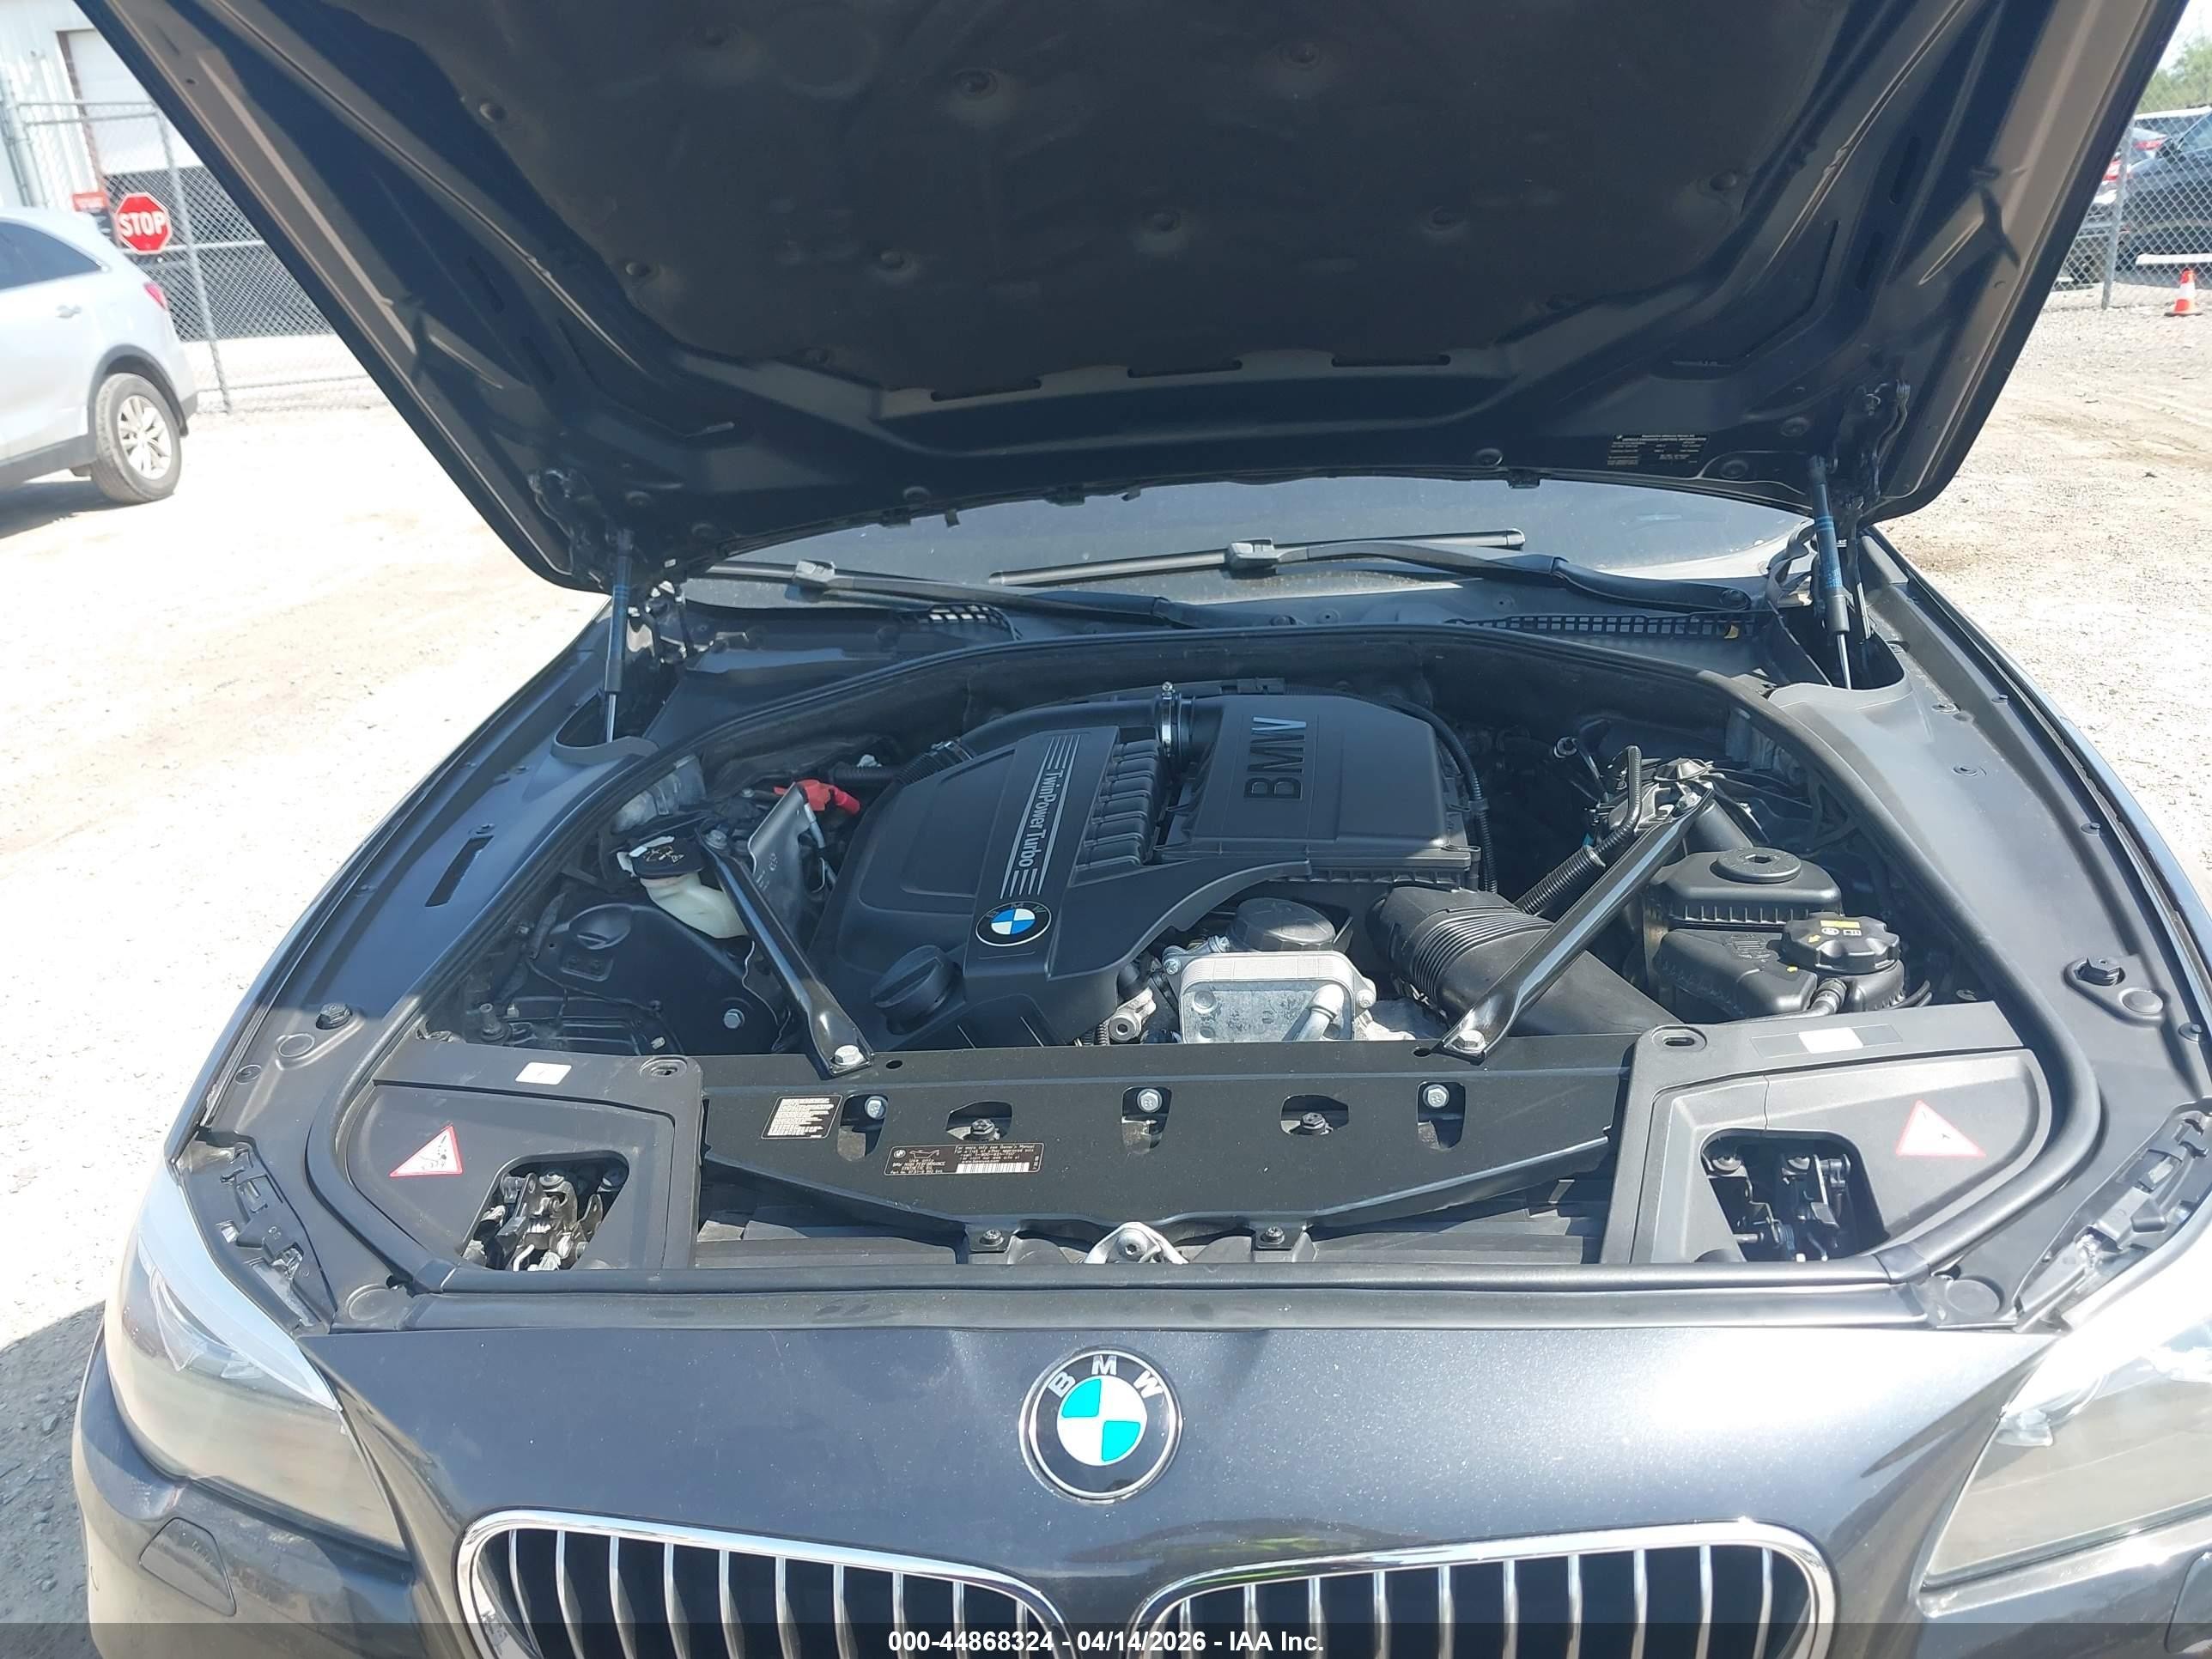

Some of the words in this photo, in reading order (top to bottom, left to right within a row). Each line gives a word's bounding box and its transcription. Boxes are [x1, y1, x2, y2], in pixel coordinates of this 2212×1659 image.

[119, 211, 167, 237] STOP
[1243, 715, 1306, 799] BMW
[1048, 1355, 1165, 1398] BMW
